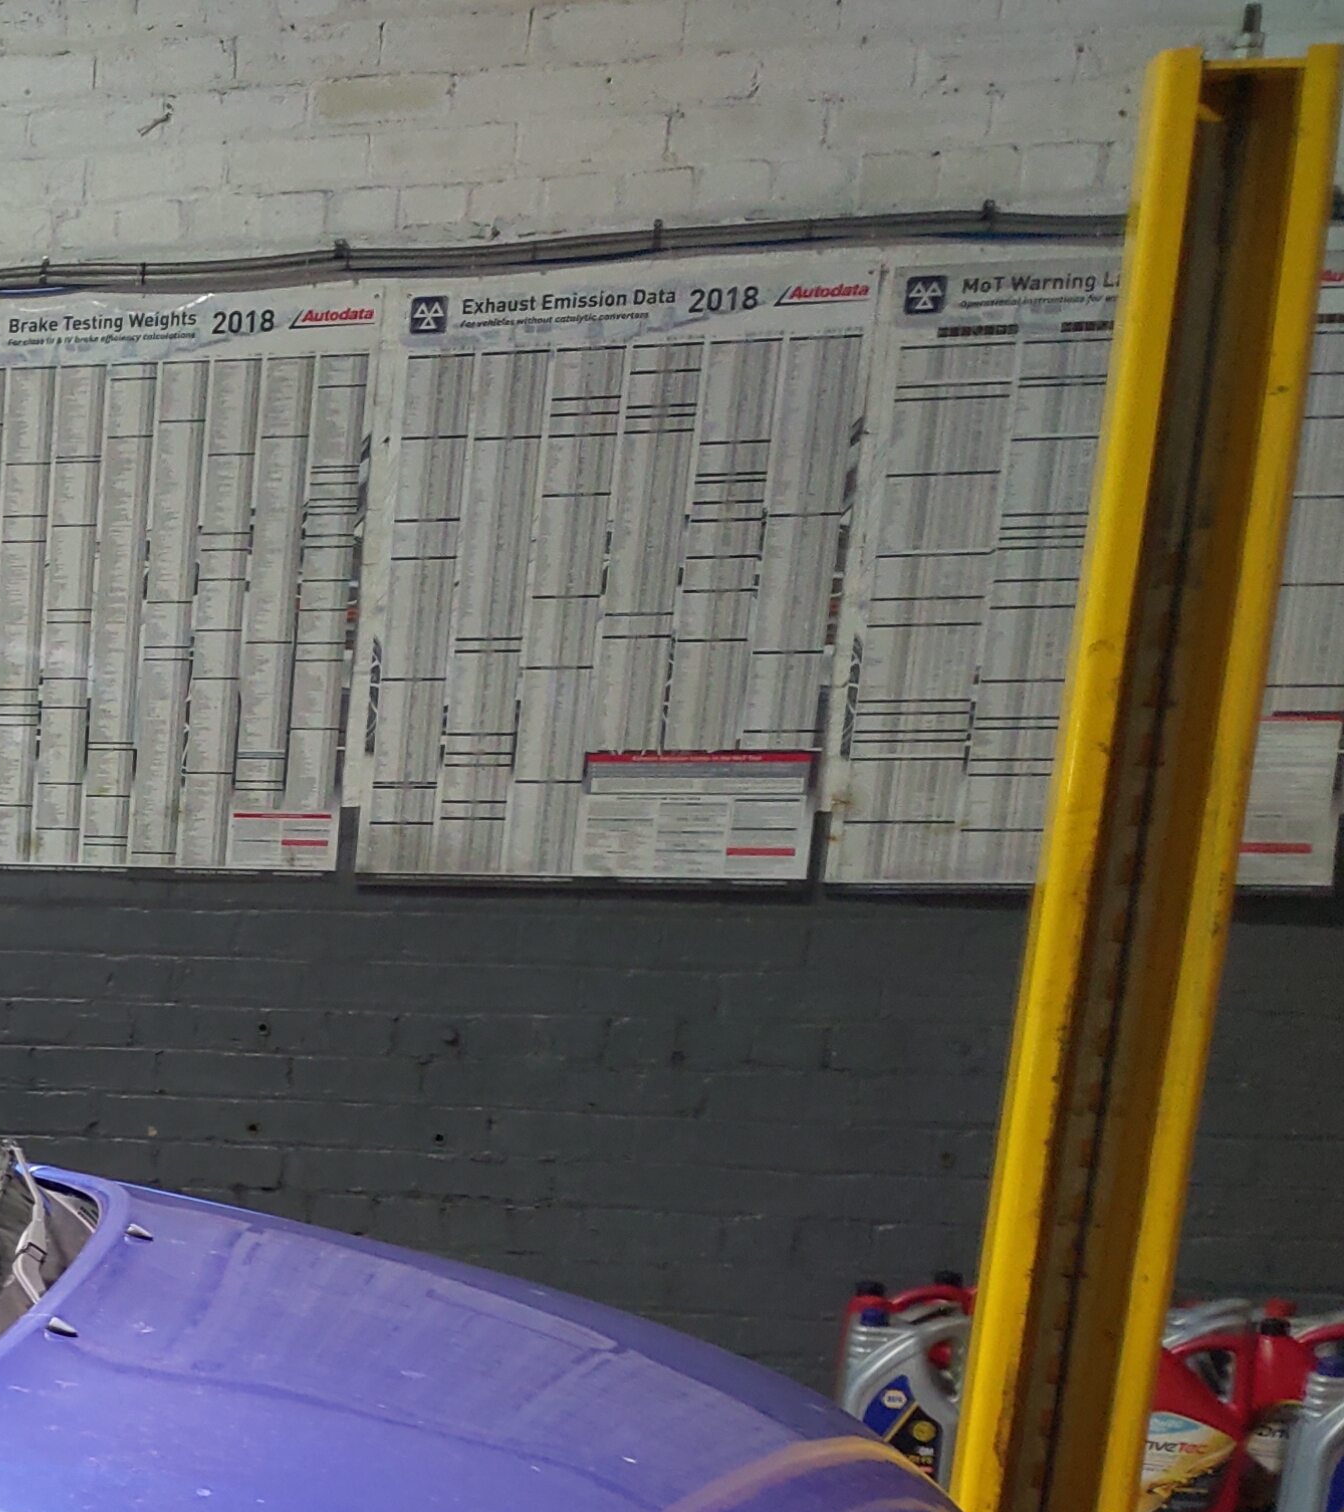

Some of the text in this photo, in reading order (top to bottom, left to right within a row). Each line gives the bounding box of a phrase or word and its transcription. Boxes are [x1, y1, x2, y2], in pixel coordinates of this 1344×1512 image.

[789, 283, 870, 300] Autodata
[962, 276, 1005, 294] MoT
[1012, 273, 1097, 292] Warning
[462, 288, 676, 315] Exhaust Emission Data
[688, 286, 759, 313] 2018
[8, 311, 197, 333] Brake Testing Weights
[212, 309, 275, 334] 2018
[302, 308, 374, 322] Autodata
[516, 315, 552, 326] without
